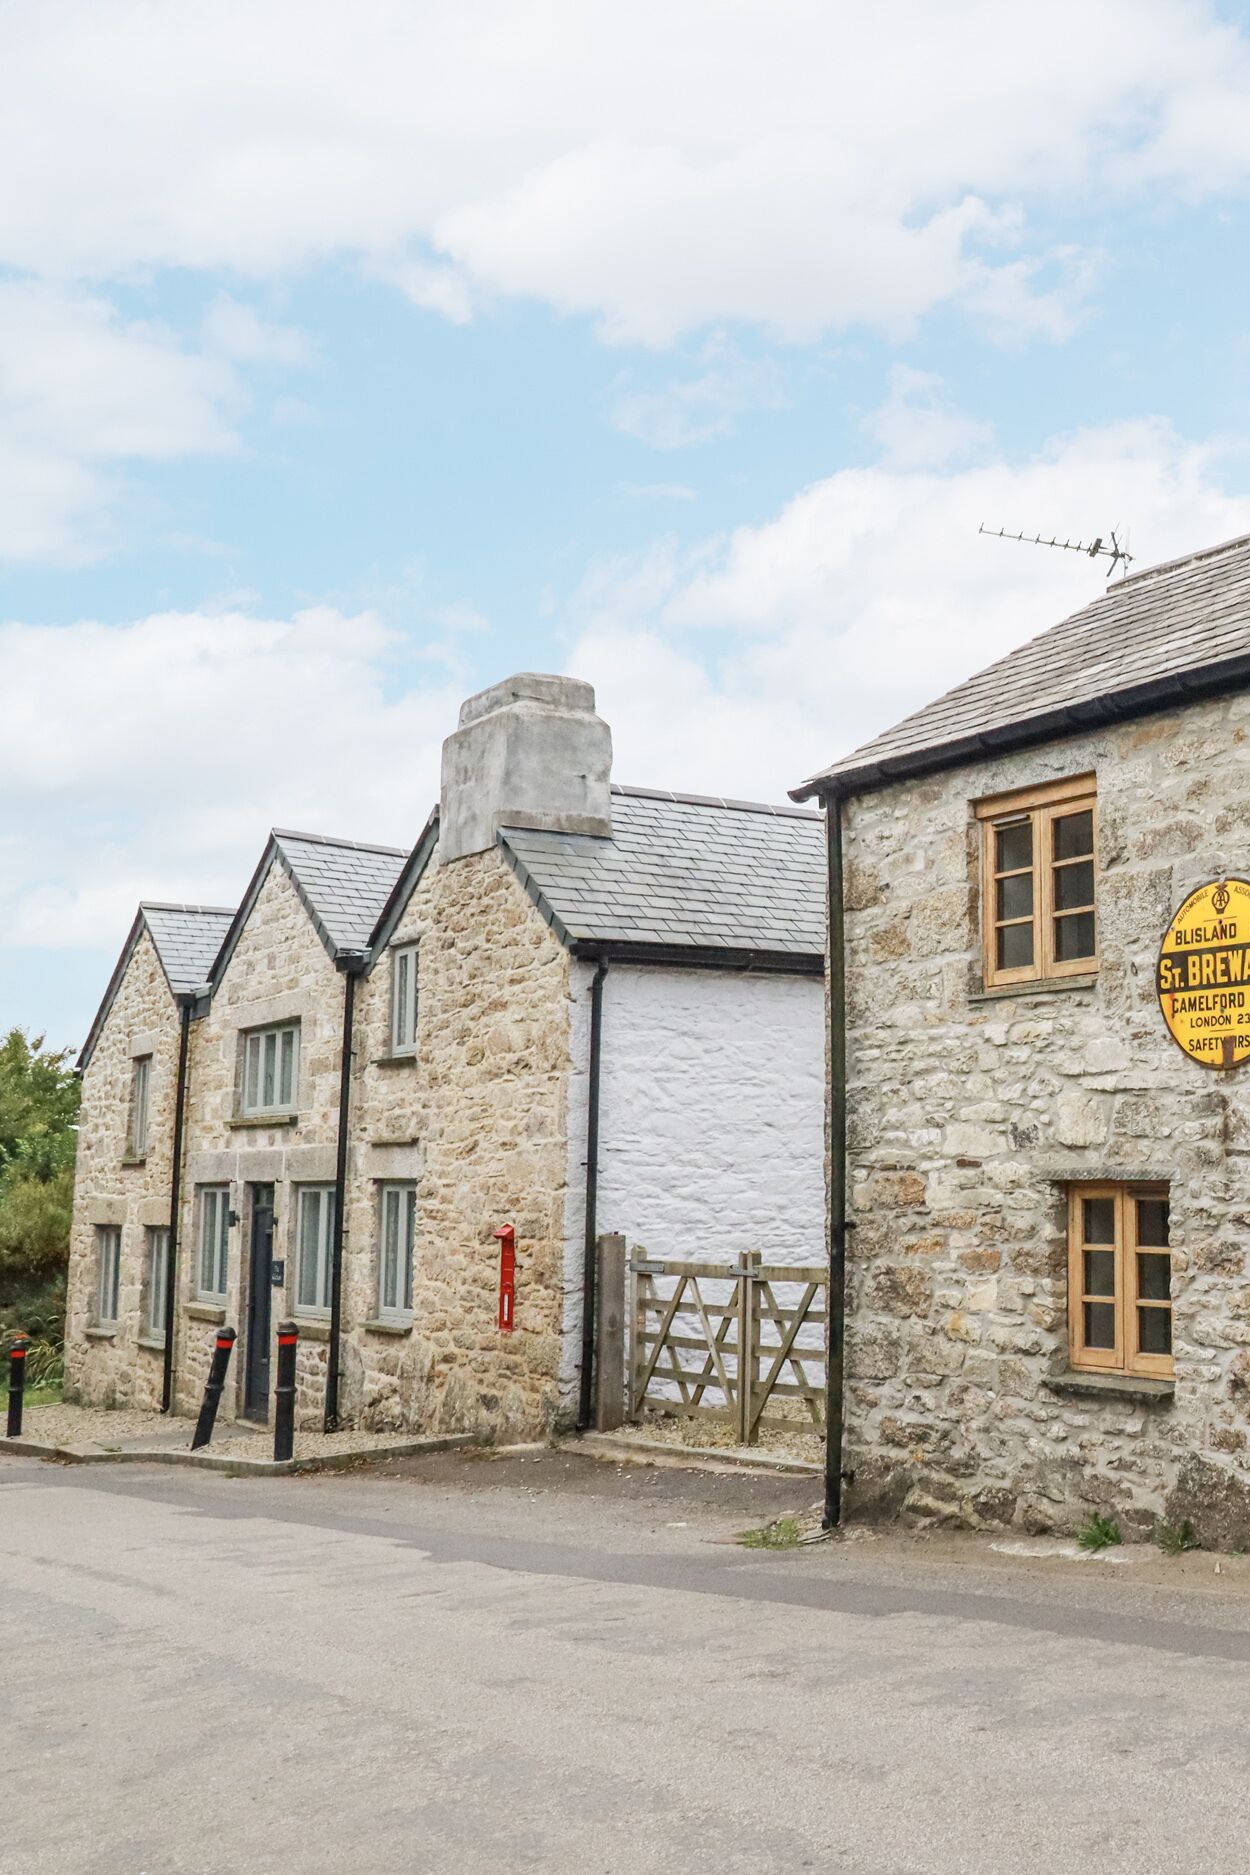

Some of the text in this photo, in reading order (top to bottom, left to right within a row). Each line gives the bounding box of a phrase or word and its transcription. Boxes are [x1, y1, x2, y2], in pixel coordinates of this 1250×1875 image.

[1178, 890, 1208, 924] AUTOMOBILE
[1175, 923, 1237, 946] BLISLAND
[1172, 992, 1245, 1014] CAMELFORD
[1190, 1014, 1231, 1029] LONDON
[1189, 1037, 1225, 1052] SAFETY
